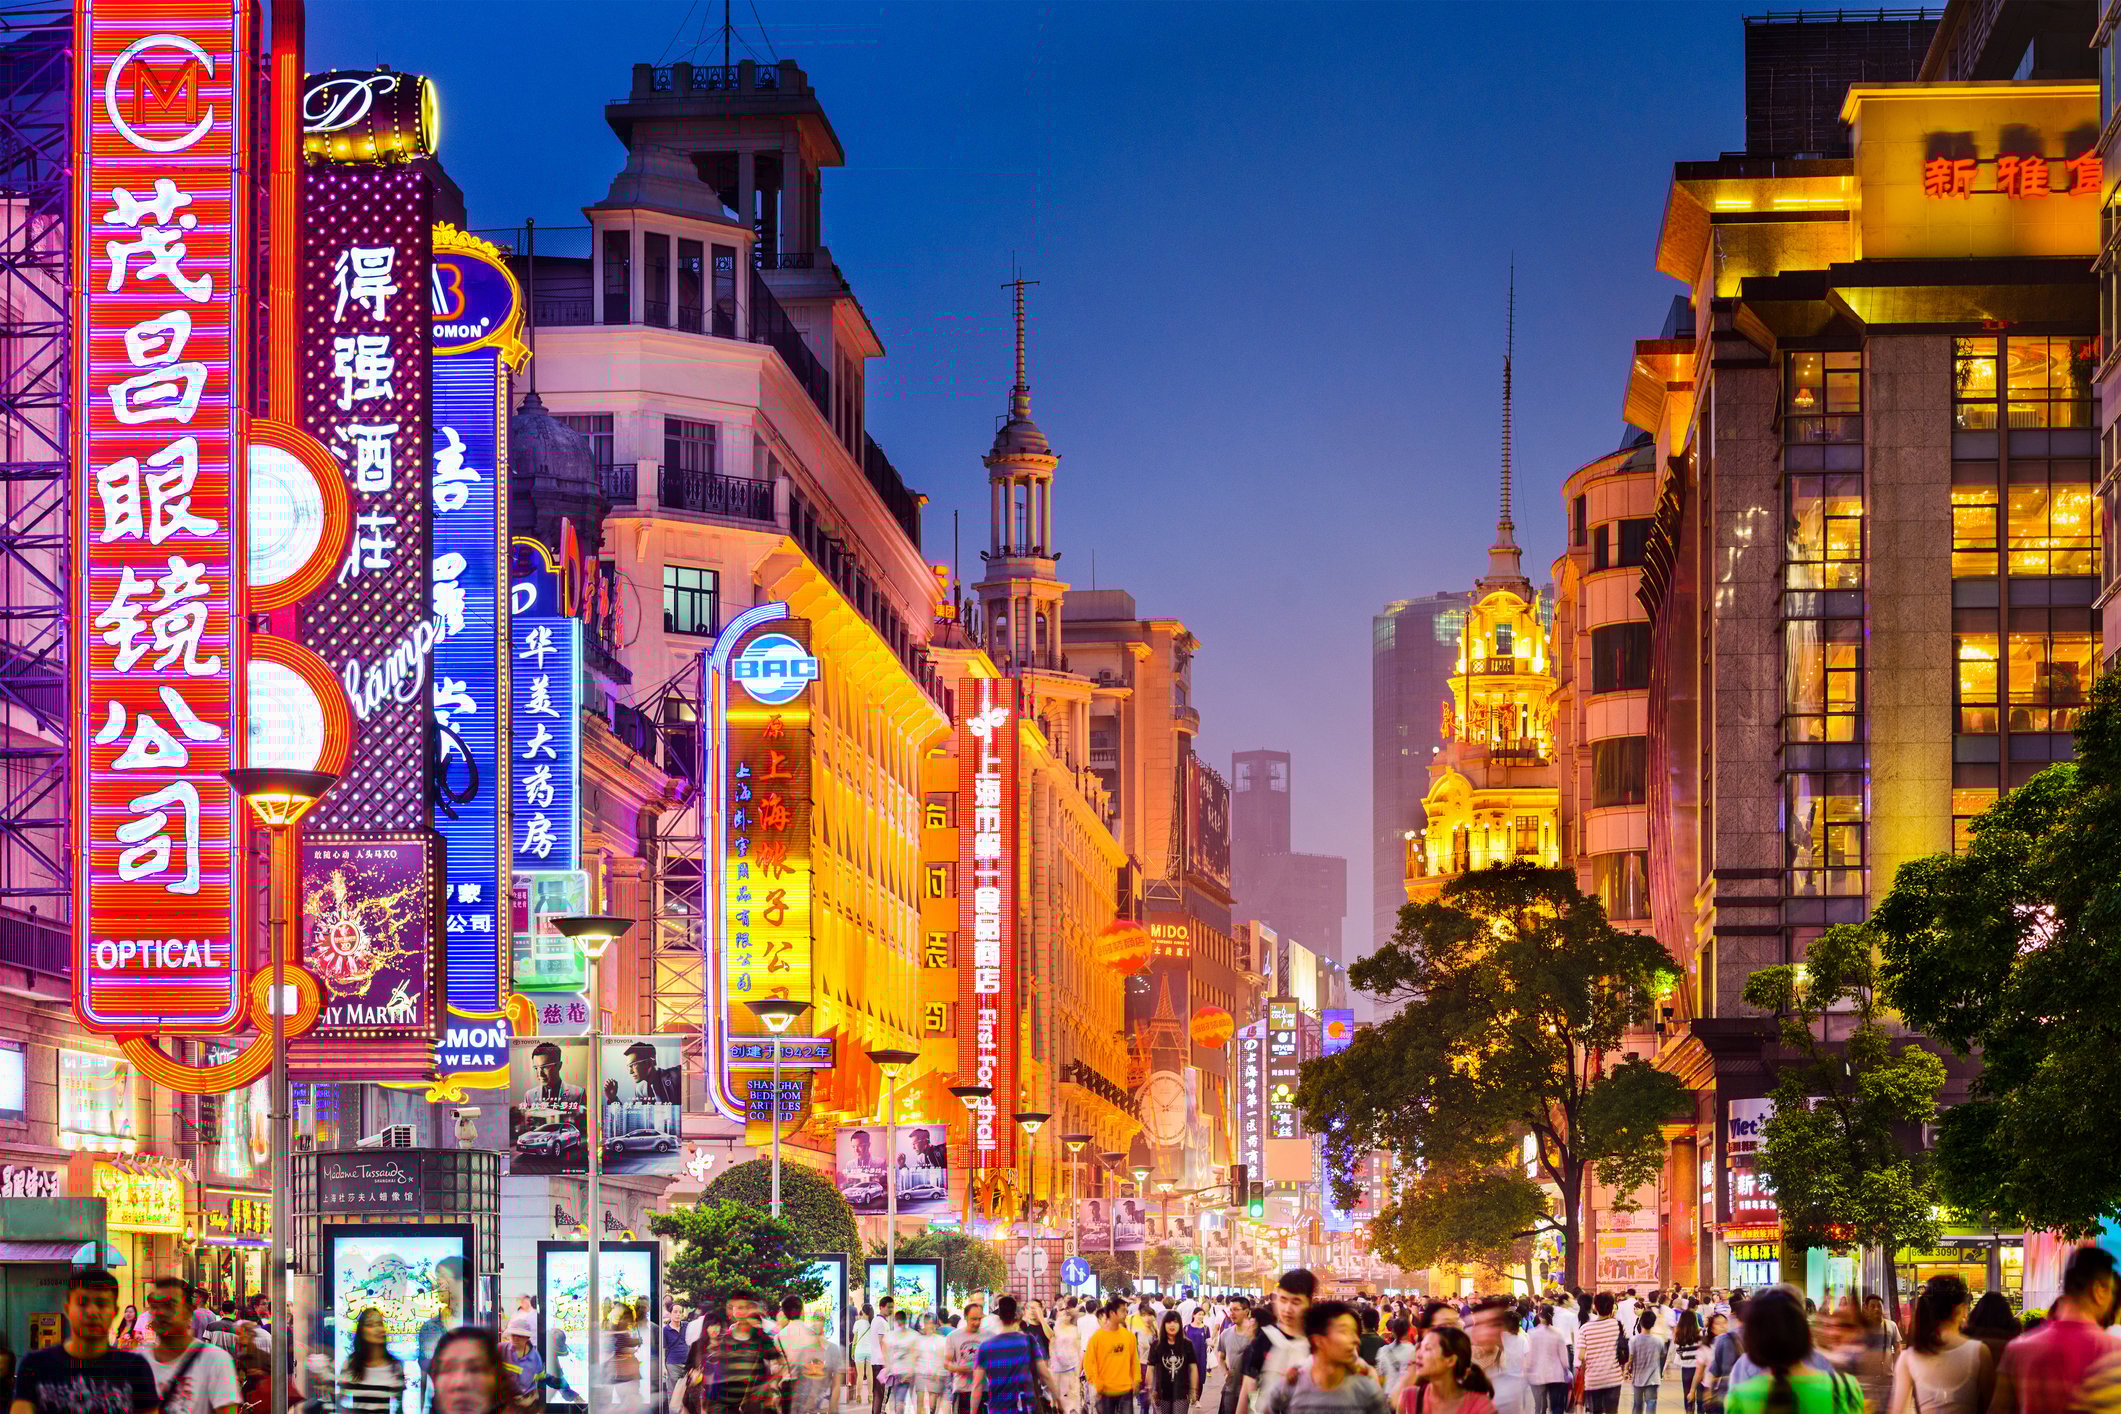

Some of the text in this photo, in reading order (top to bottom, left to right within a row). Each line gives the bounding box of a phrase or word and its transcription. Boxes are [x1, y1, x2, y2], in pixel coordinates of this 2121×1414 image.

[95, 178, 222, 896] 茂昌眼镜公司
[735, 659, 816, 678] BAC
[518, 625, 561, 859] 华美大药房
[95, 939, 222, 971] OPTICAL
[445, 1054, 496, 1065] WEAR
[323, 1162, 406, 1184] Madame Tussauds
[1935, 1248, 1958, 1257] 3090
